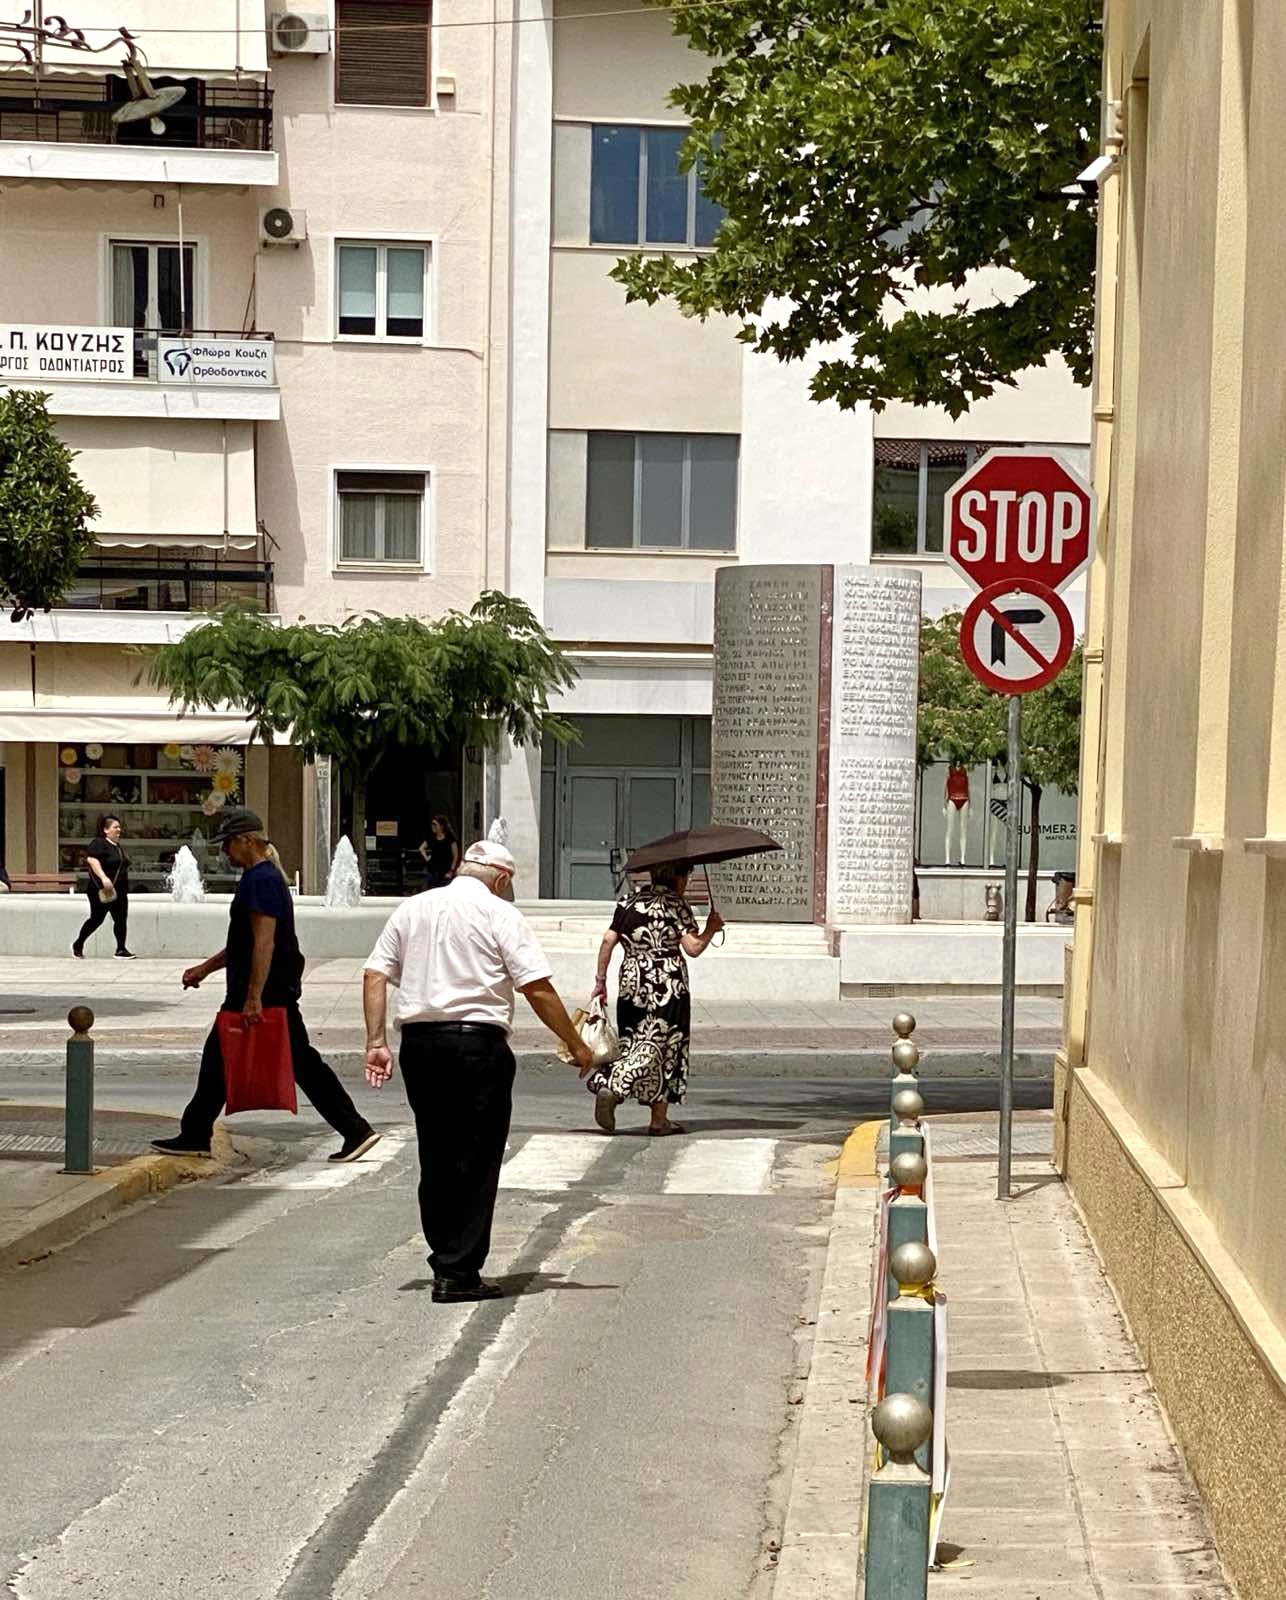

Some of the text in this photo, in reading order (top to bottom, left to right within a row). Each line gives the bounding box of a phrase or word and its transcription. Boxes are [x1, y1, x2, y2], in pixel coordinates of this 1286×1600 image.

[37, 332, 124, 352] ΚΟΥΖΗΣ
[40, 358, 124, 373] ΟΔΟΝΤΙΑΤΡΟΣ
[958, 490, 1082, 564] STOP
